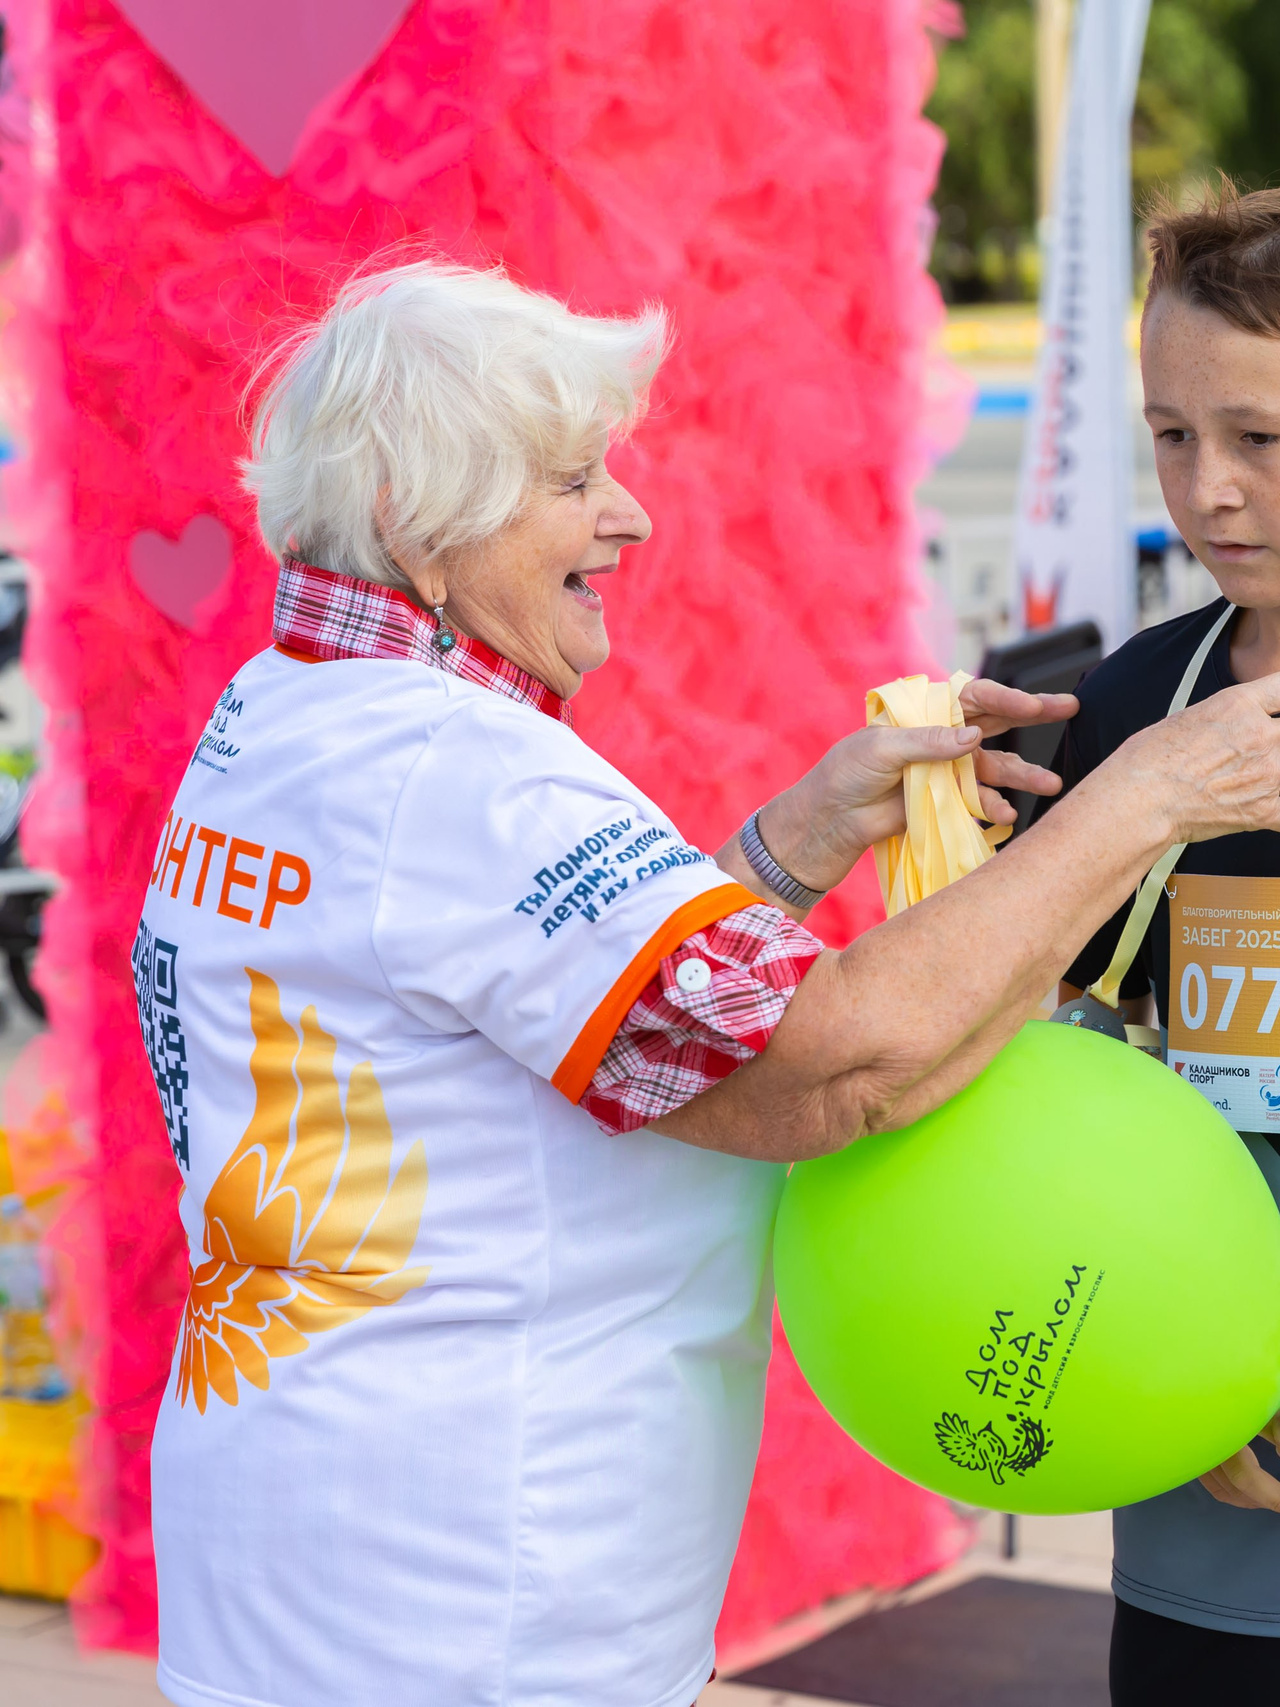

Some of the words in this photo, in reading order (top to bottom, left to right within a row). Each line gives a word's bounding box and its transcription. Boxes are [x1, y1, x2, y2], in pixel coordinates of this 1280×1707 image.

[1182, 926, 1231, 947] ЗАБЕГ
[1189, 1063, 1251, 1078] КАЛАШНИКОВ
[1189, 1073, 1215, 1085] СПОРТ
[1087, 1268, 1106, 1304] ХОСПИС
[1015, 1264, 1087, 1407] крылом
[992, 1331, 1036, 1398] под
